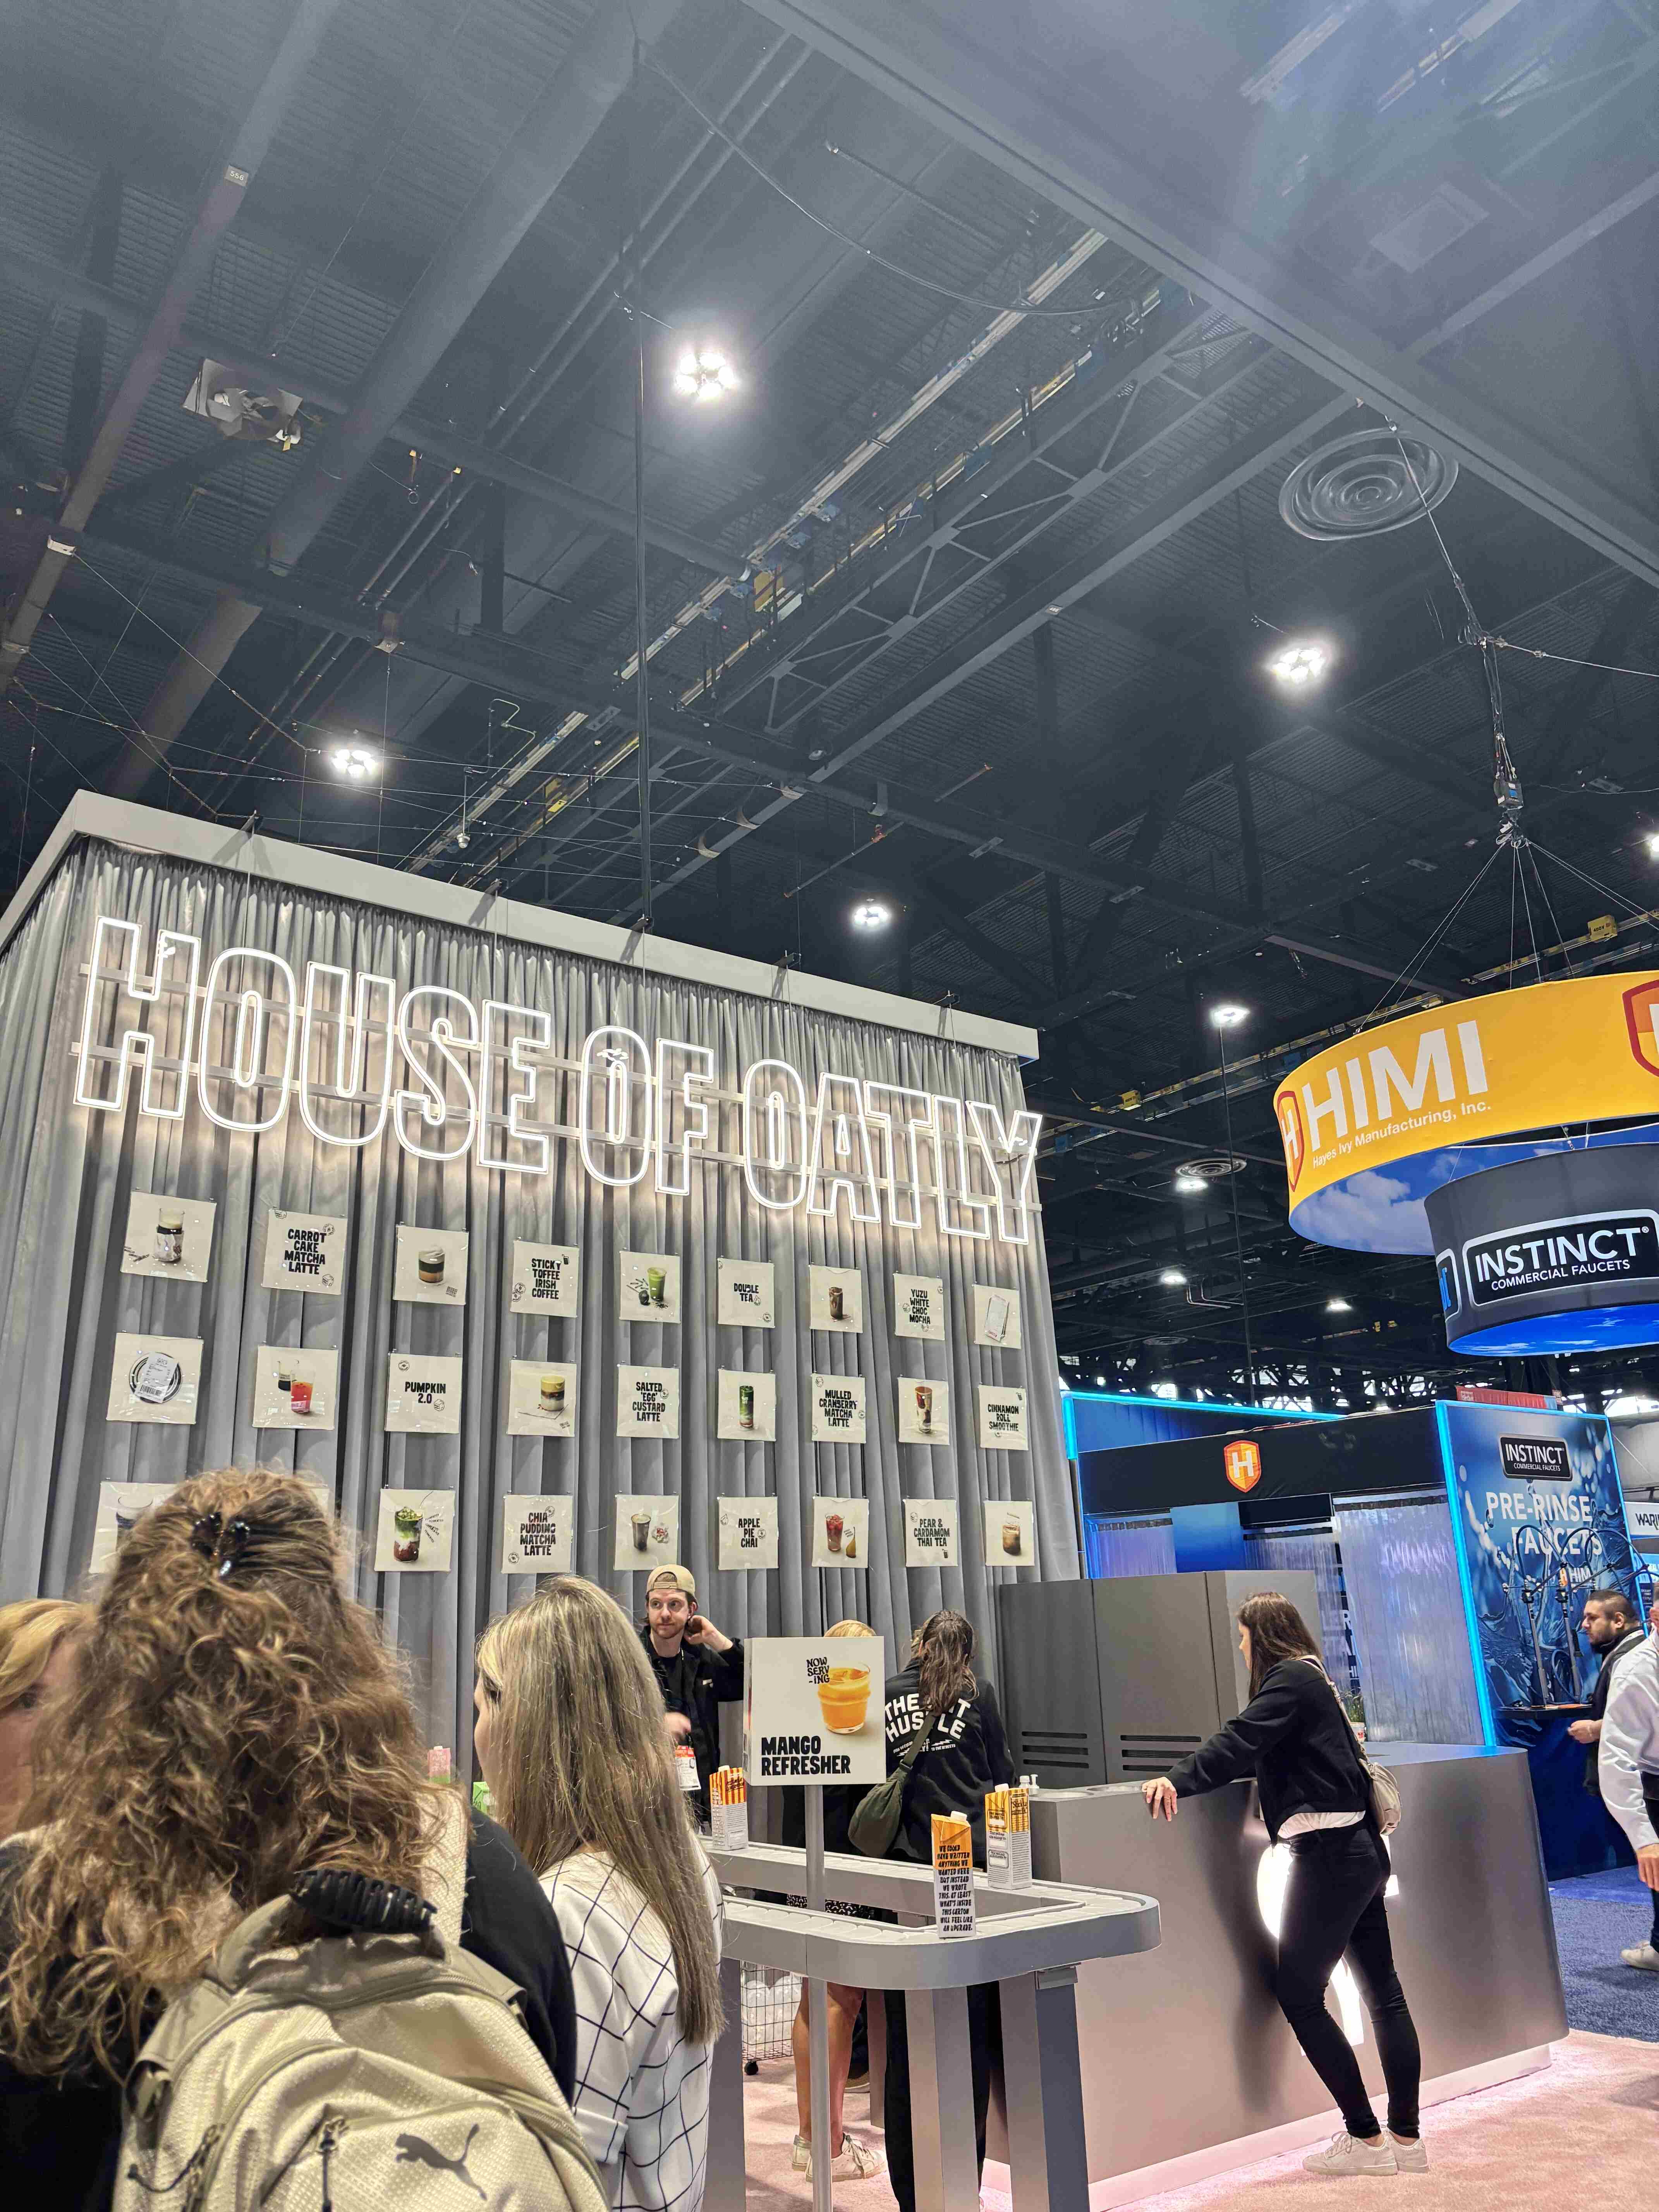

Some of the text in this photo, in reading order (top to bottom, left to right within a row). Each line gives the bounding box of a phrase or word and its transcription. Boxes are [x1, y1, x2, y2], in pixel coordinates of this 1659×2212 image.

[230, 170, 244, 180] 556
[74, 915, 1043, 1245] HOUSE OF OATLY
[1302, 1020, 1488, 1152] HIMI
[1312, 1099, 1491, 1169] Hayes Ivy Manufacturing, Inc.
[288, 1229, 326, 1243] CARROT
[293, 1240, 318, 1253] CAKE
[284, 1250, 325, 1265] MATCHA
[288, 1261, 319, 1274] LATTE
[531, 1258, 561, 1271] STICKY
[532, 1268, 560, 1280] TOFFEE
[1491, 1260, 1630, 1291] COMMERCIAL FAUCETS
[536, 1280, 556, 1289] IRISH
[734, 1283, 759, 1293] DOUBLE
[532, 1288, 559, 1300] COFFEE
[740, 1293, 753, 1302] TEA
[911, 1289, 927, 1299] YUZU
[910, 1298, 929, 1308] WHITE
[912, 1306, 927, 1316] CHOC
[909, 1314, 930, 1324] MOCHA
[405, 1381, 446, 1394] PUMPKIN
[636, 1382, 662, 1392] SALTED
[418, 1394, 432, 1404] 2.0
[825, 1390, 851, 1400] MULLED
[632, 1402, 665, 1413] CUSTARD
[819, 1398, 857, 1410] CRANBERRY
[988, 1404, 1019, 1415] CINNAMON
[637, 1412, 660, 1422] LATTE
[824, 1408, 852, 1419] MATCHA
[996, 1413, 1010, 1423] ROLL
[828, 1417, 850, 1427] LATTE
[989, 1421, 1019, 1432] SMOOTHIE
[1231, 1450, 1254, 1479] H
[1513, 1462, 1561, 1472] COMMERCIAL FAUCETS
[1486, 1492, 1593, 1522] PRE-RINSE
[528, 1512, 547, 1523] CHIA
[738, 1518, 760, 1528] APPLE
[920, 1518, 943, 1528] PEAR &
[1635, 1513, 1659, 1530] WARI
[520, 1523, 556, 1534] PUDDING
[744, 1528, 755, 1538] PIE
[914, 1527, 950, 1538] CARDAMOM
[520, 1534, 556, 1545] MATCHA
[741, 1538, 757, 1548] CHAI
[917, 1537, 947, 1547] THAI TEA
[1511, 1527, 1602, 1555] FAUCETS
[524, 1545, 551, 1556] LATTE
[806, 1657, 827, 1668] NOW
[807, 1665, 829, 1676] SERV
[884, 1693, 919, 1721] THE
[886, 1712, 966, 1743] HUSLE
[761, 1736, 821, 1755] MANGO
[761, 1755, 851, 1776] REFRESHER
